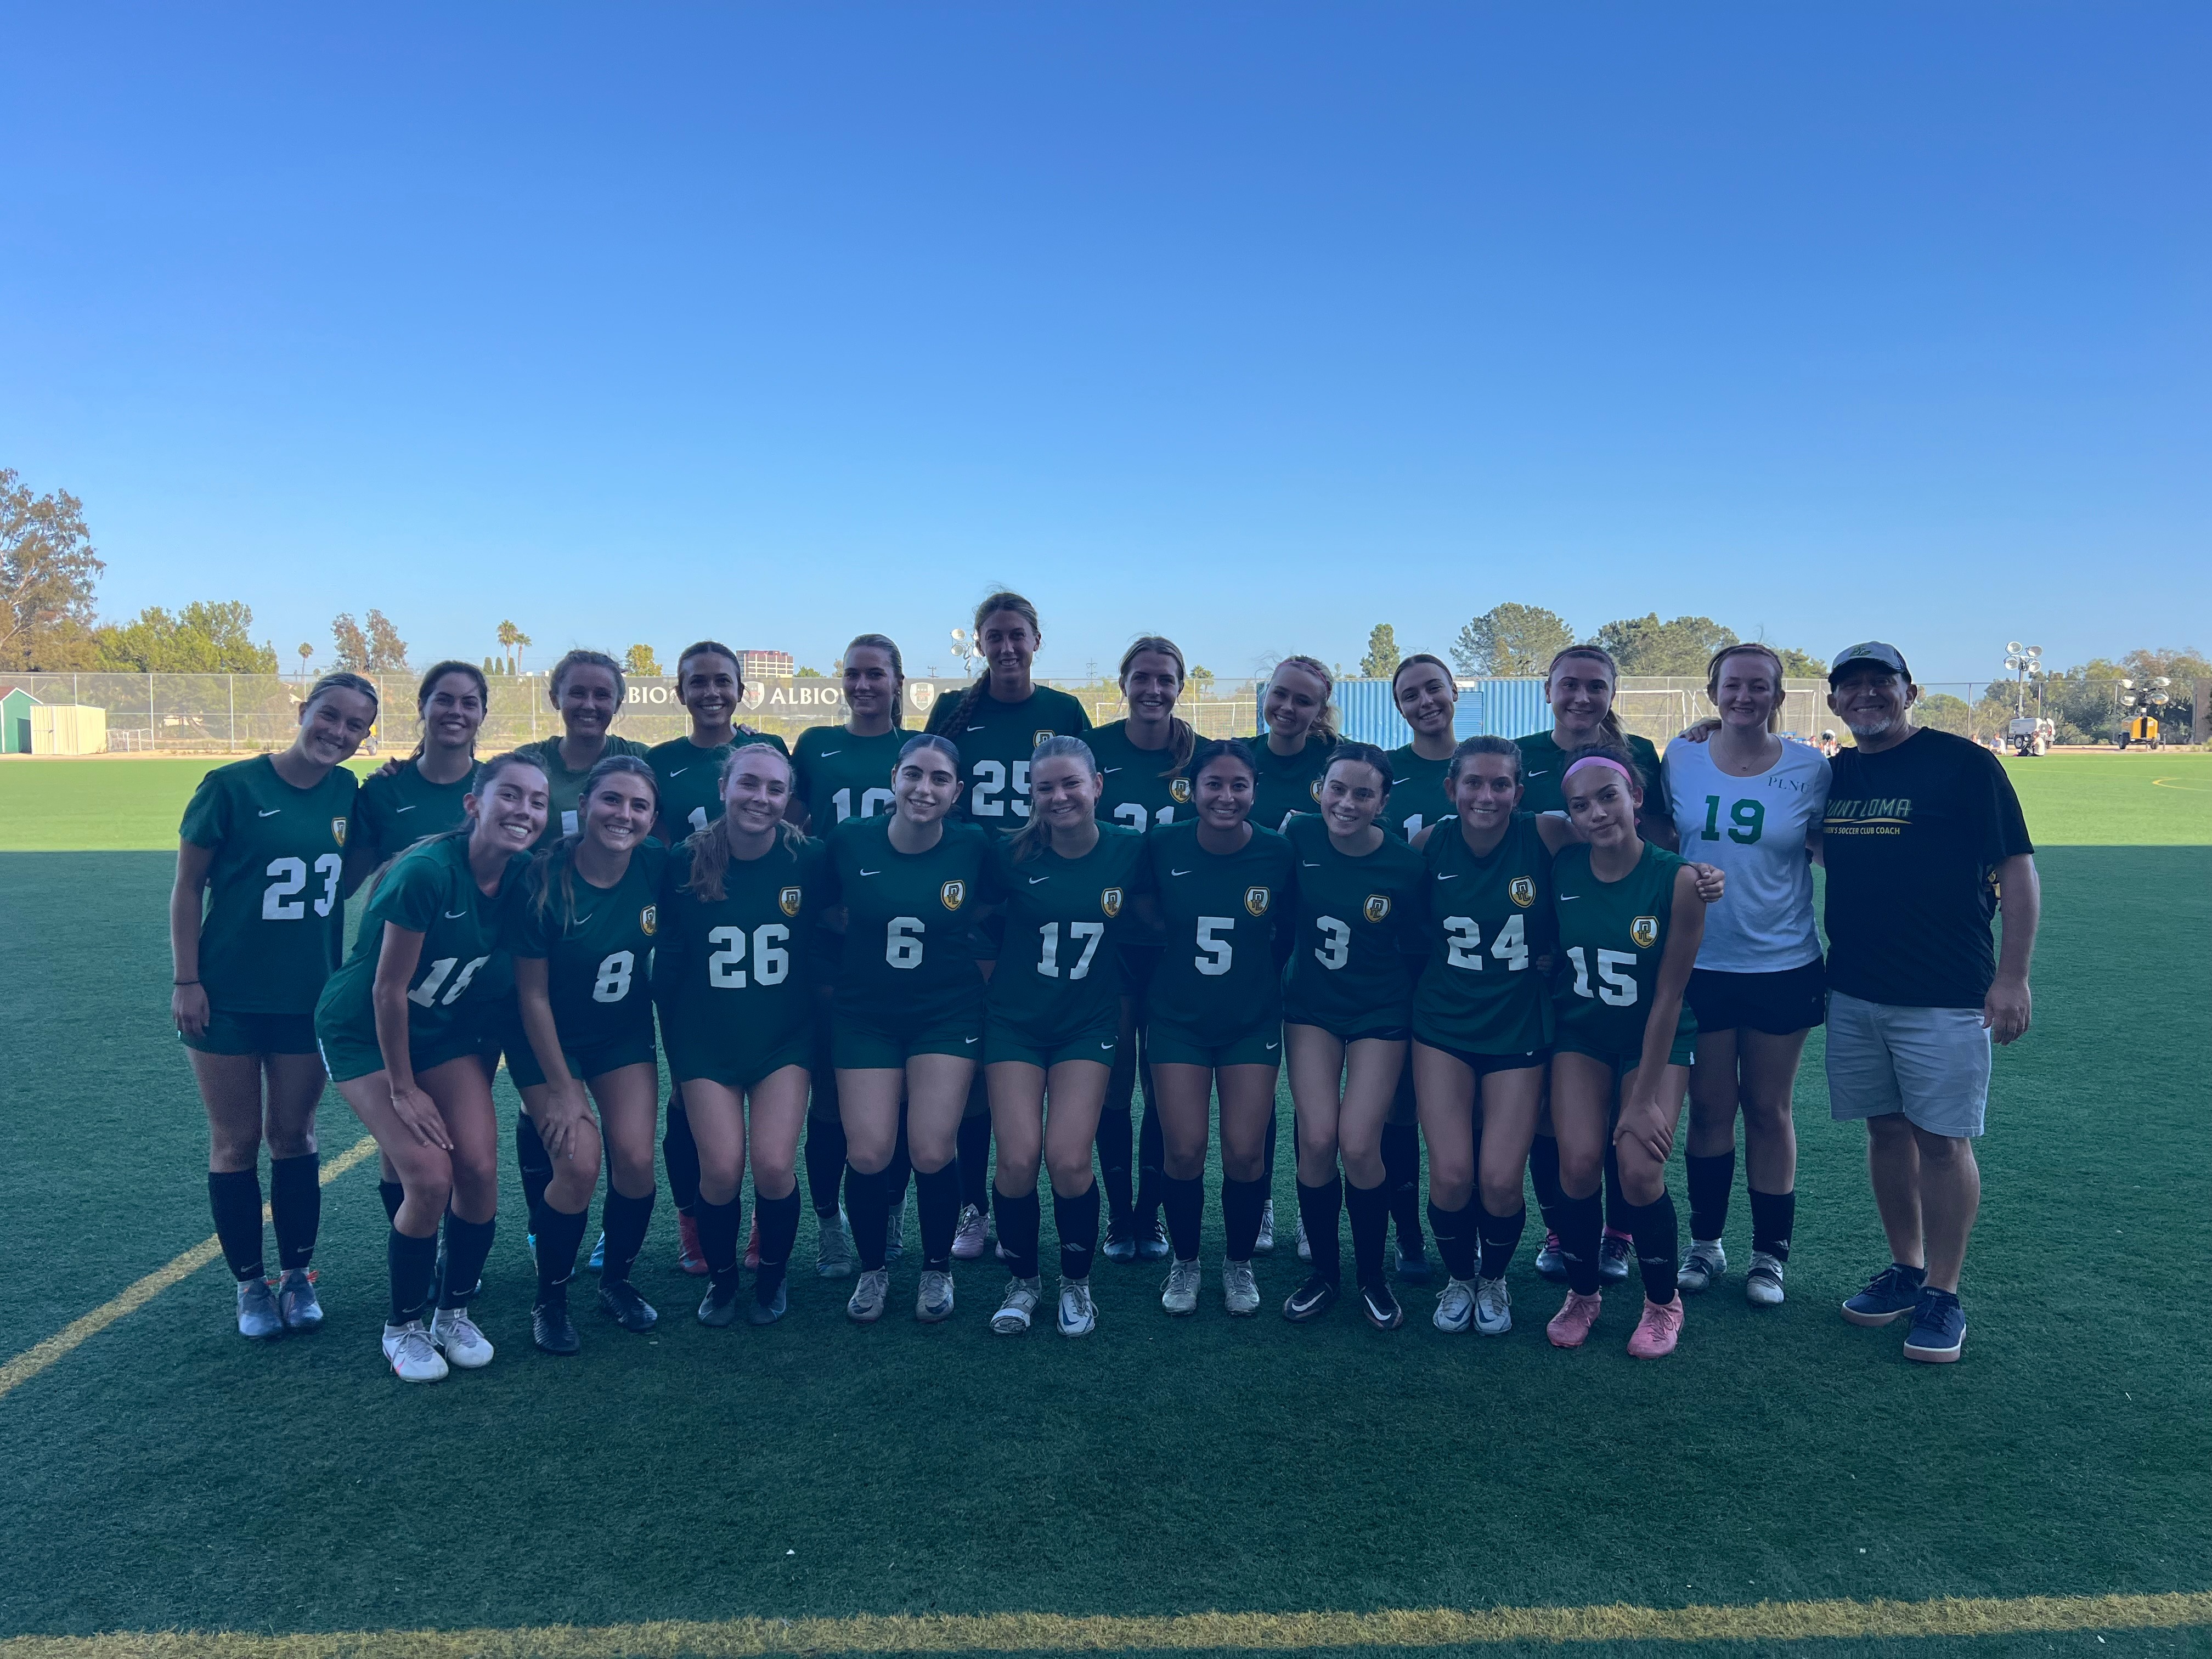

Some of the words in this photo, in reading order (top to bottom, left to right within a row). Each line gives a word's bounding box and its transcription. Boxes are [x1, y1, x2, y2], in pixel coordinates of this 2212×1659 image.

[769, 687, 845, 704] ALBIO
[1768, 777, 1811, 794] PLNU
[1701, 795, 1765, 845] 19
[1875, 826, 1900, 835] COACH
[262, 853, 342, 920] 23
[708, 924, 789, 989] 26
[885, 917, 926, 969] 6
[1037, 922, 1104, 980] 17
[1195, 916, 1235, 975] 5
[1314, 915, 1351, 970] 3
[1443, 914, 1529, 971] 24
[592, 950, 635, 1003] 8
[1566, 946, 1638, 1007] 15
